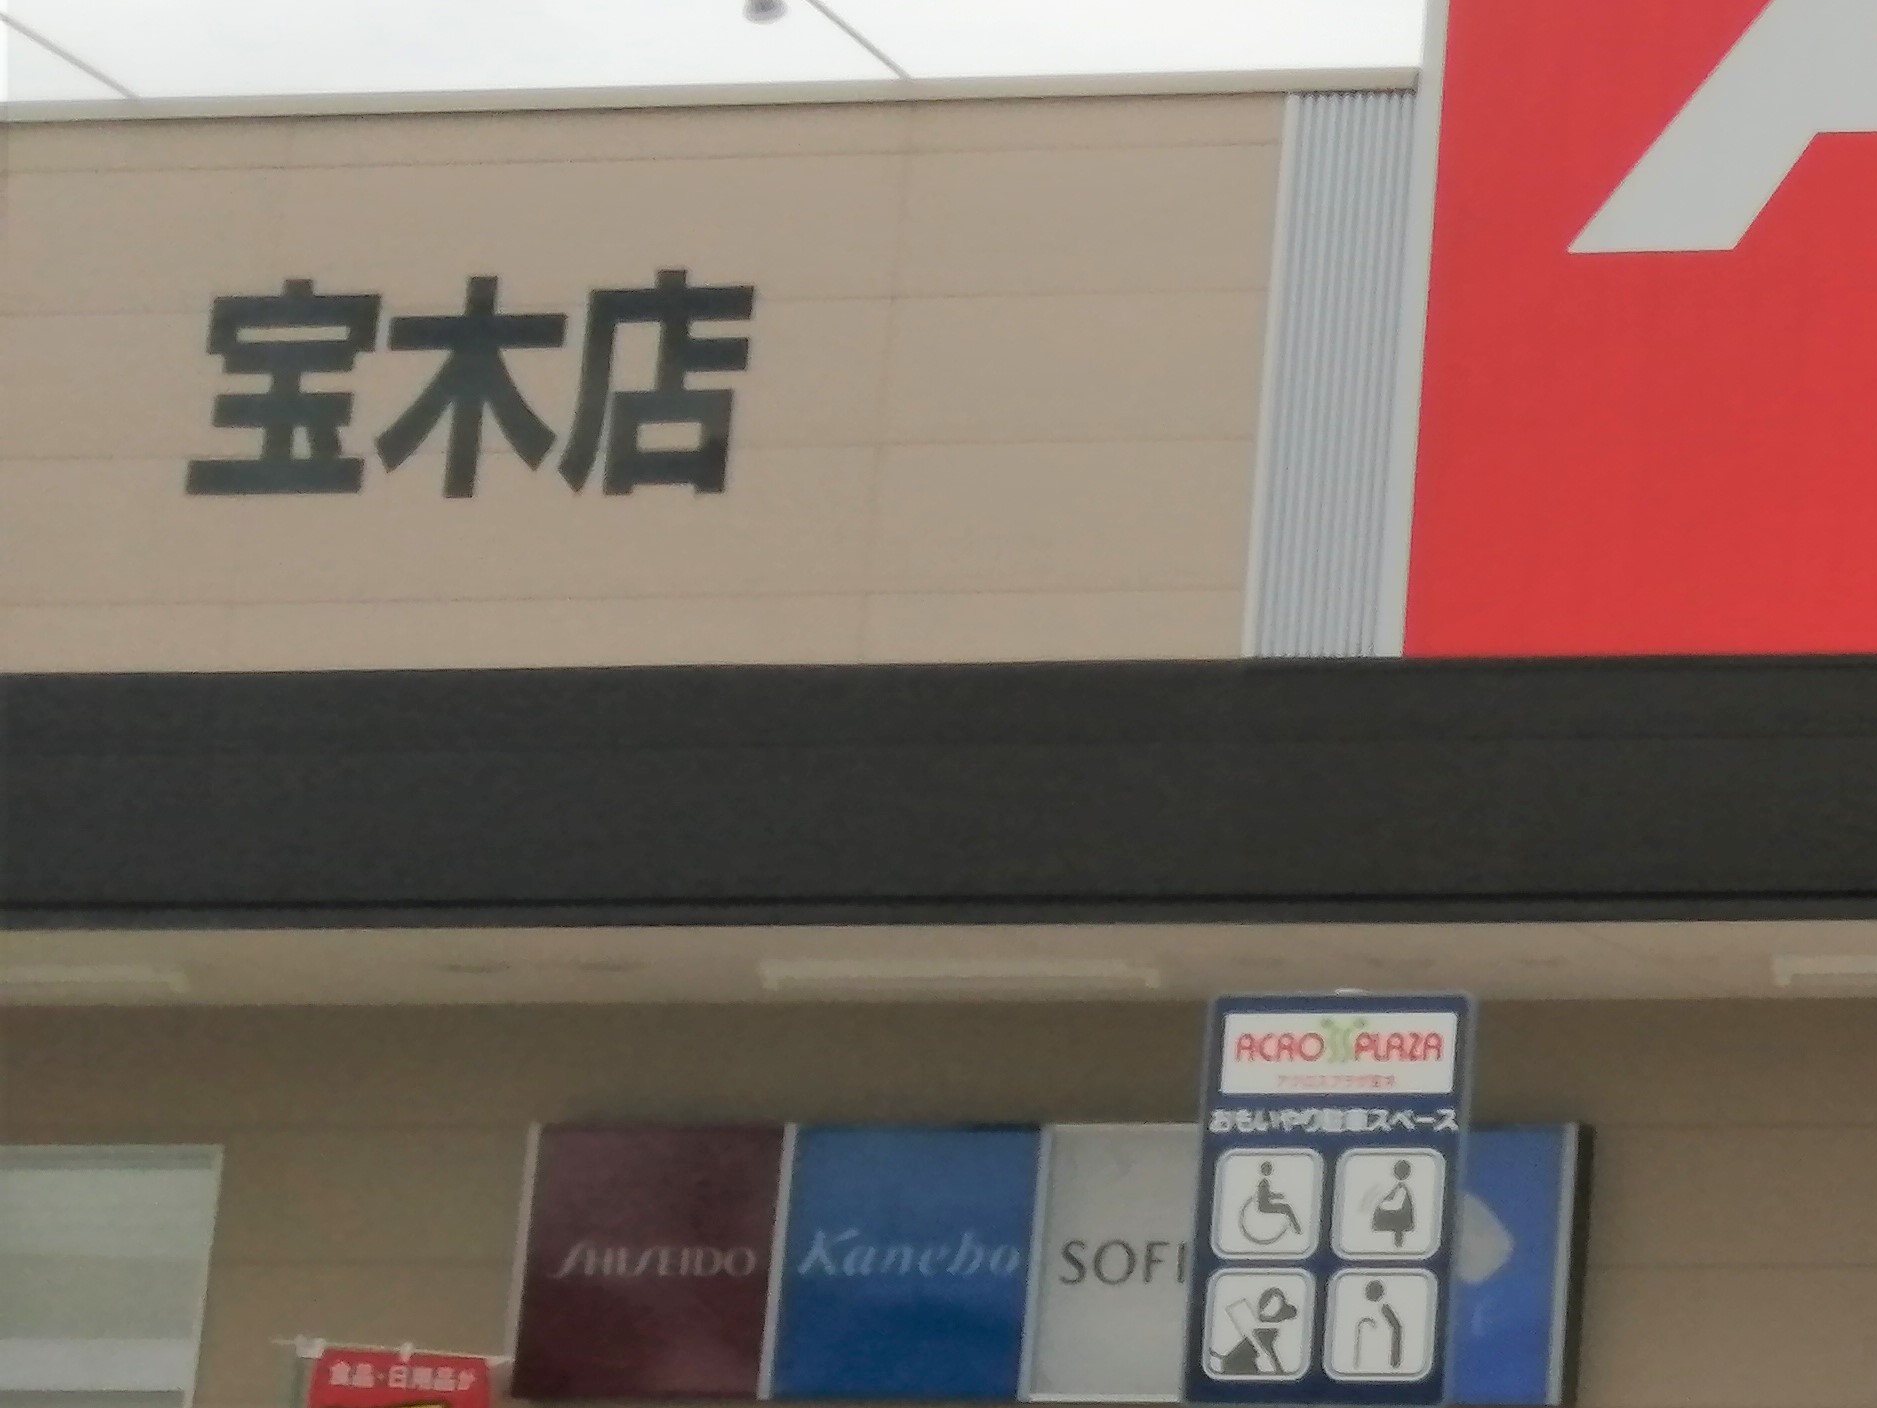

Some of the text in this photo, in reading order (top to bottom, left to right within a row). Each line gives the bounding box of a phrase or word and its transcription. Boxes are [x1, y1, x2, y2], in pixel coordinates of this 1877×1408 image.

[185, 269, 755, 499] 宝木店
[549, 1241, 757, 1280] SHISEIDO
[798, 1227, 1022, 1278] Kanebo
